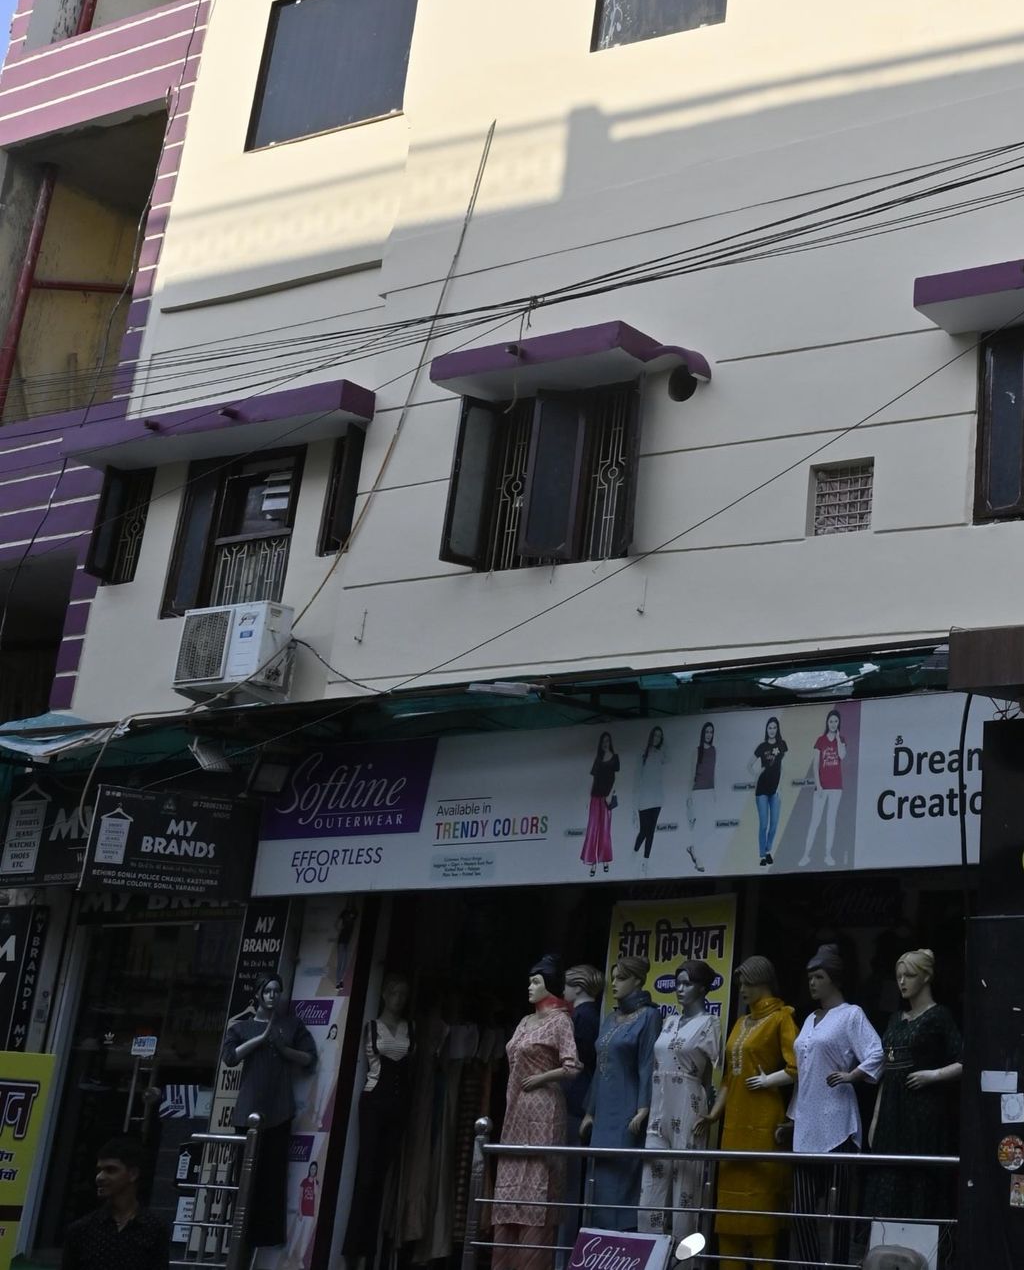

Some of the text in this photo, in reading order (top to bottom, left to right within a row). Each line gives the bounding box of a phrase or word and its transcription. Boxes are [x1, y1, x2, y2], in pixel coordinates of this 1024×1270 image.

[276, 751, 407, 825] Softline
[436, 802, 492, 817] Available in
[165, 818, 198, 837] MY
[314, 813, 403, 829] OUTERWEAR
[434, 815, 549, 840] TRENDY COLORS
[140, 836, 217, 859] BRANDS
[291, 846, 384, 867] EFFORTLESS
[295, 867, 330, 884] YOU
[254, 916, 276, 934] MY
[242, 938, 281, 953] BRANDS
